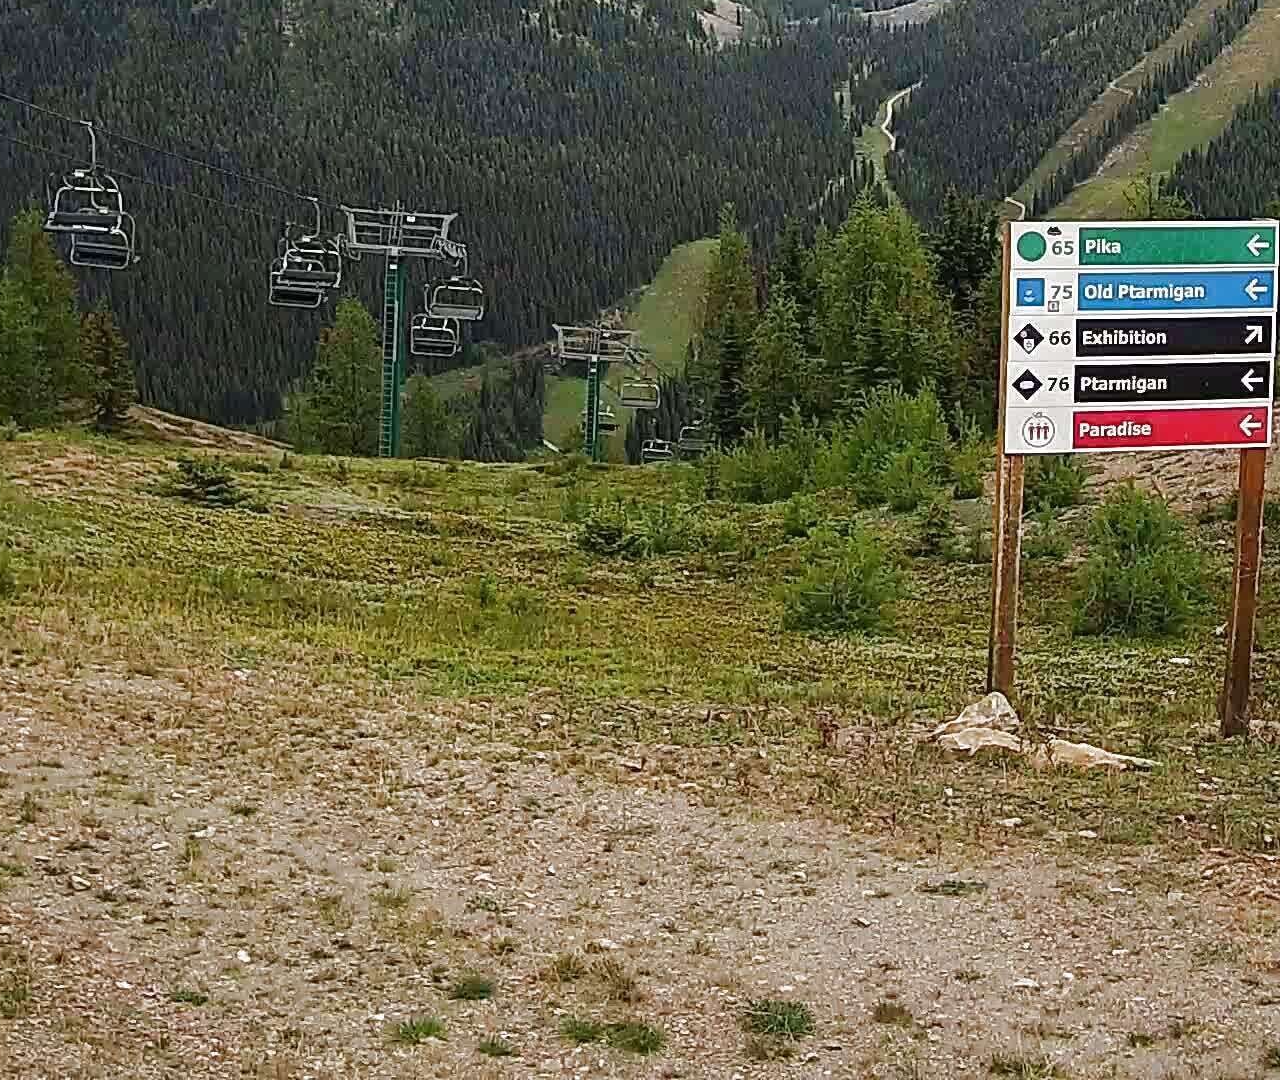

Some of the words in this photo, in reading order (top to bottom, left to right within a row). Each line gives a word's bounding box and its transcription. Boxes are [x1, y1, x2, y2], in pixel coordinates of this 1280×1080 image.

[1051, 240, 1074, 255] 65
[1085, 239, 1121, 254] Pika
[1050, 284, 1073, 300] 75
[1084, 284, 1113, 299] Old
[1118, 284, 1205, 302] Ptarmigan
[1048, 330, 1072, 346] 66
[1082, 330, 1167, 345] Exhibition
[1047, 377, 1070, 392] 76
[1080, 376, 1168, 394] Ptarmigan
[1079, 422, 1152, 437] Paradise
